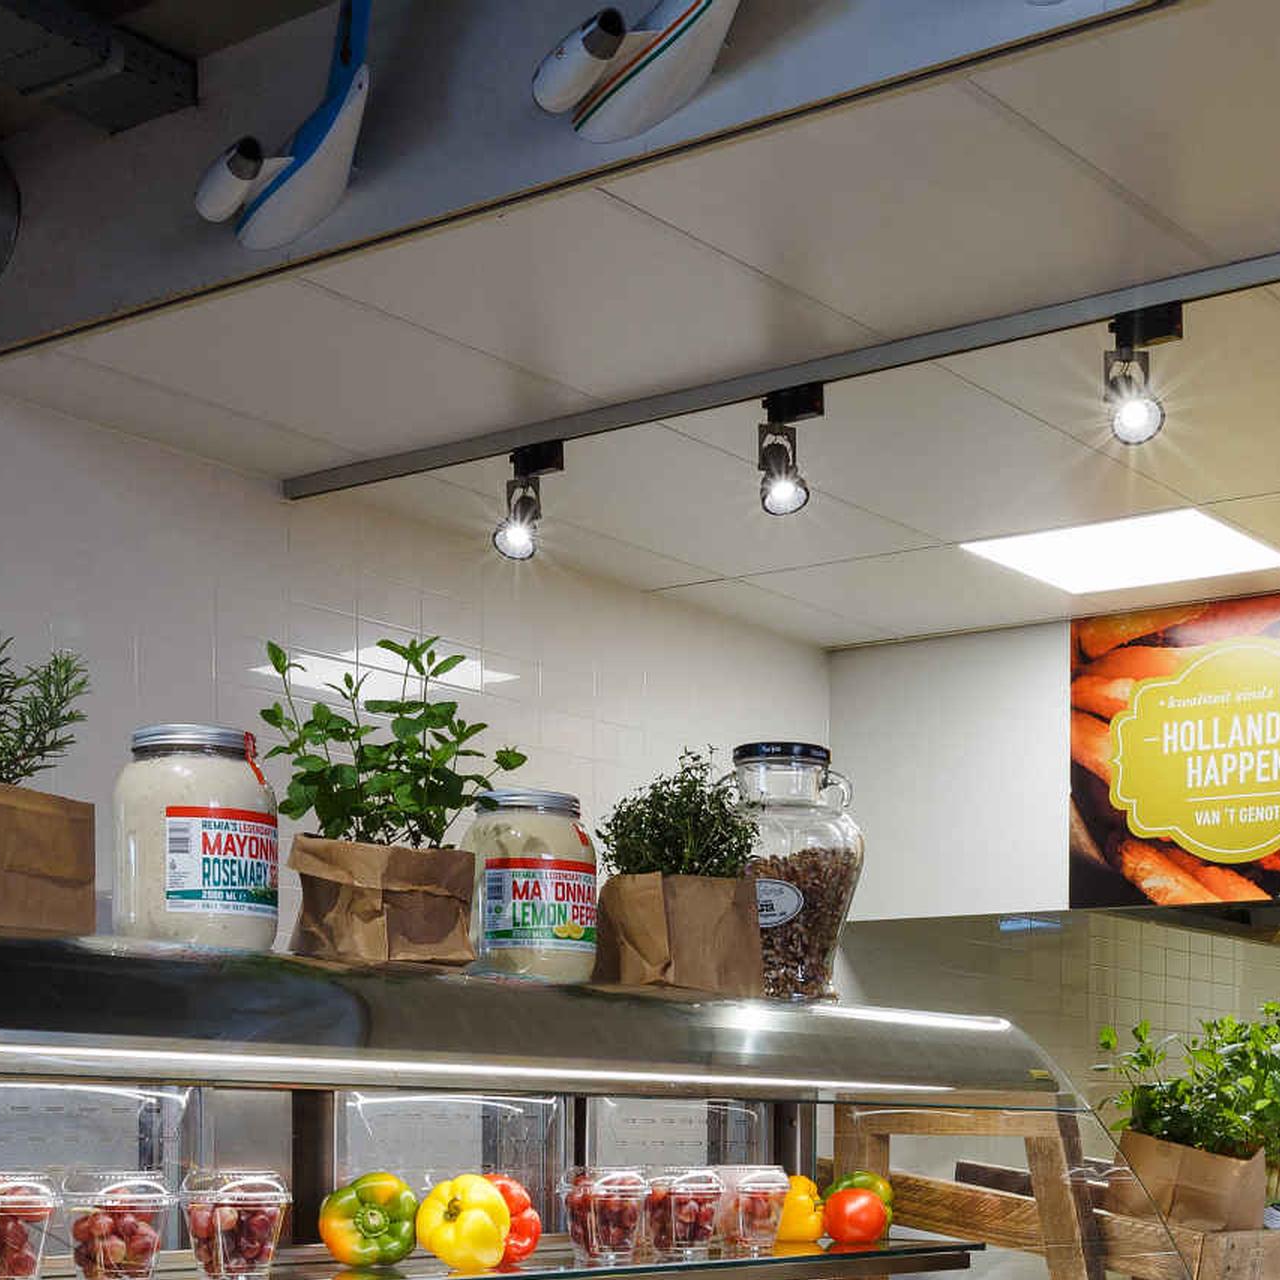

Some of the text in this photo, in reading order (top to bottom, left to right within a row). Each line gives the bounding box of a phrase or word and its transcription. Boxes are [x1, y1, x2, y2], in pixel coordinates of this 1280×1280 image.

[1194, 809, 1220, 827] VAN
[202, 857, 269, 888] ROSEMARY
[512, 900, 568, 928] LEMON
